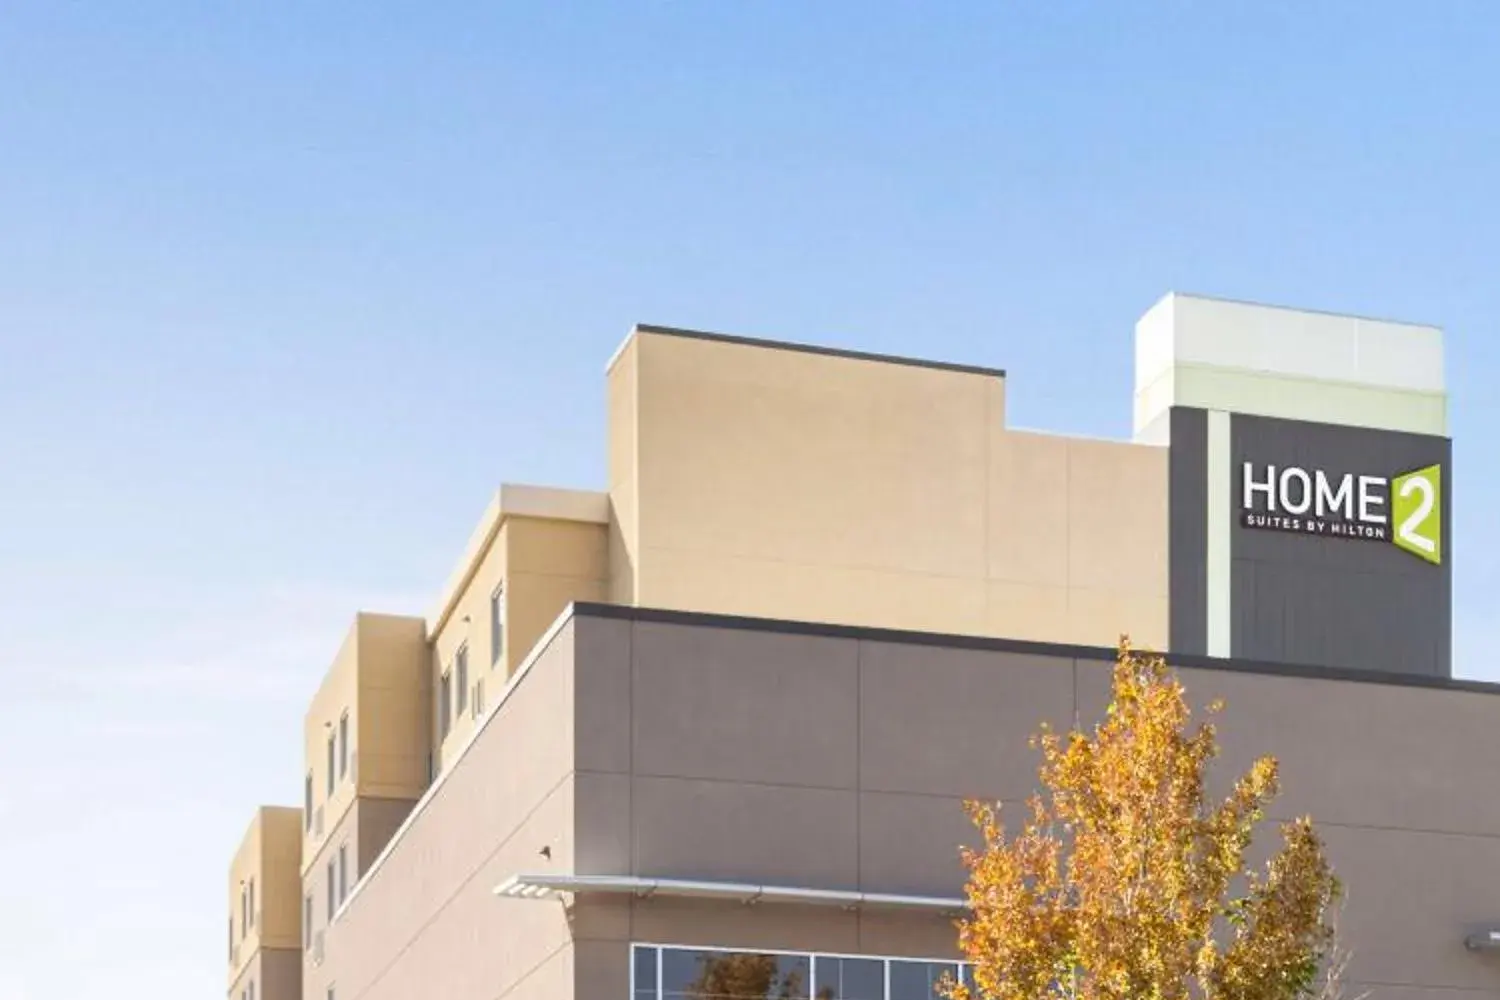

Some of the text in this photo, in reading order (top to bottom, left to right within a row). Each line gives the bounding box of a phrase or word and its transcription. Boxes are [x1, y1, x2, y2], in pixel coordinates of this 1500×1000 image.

[1243, 462, 1435, 553] HOME 2
[1247, 515, 1385, 539] SUITES BY HILTON
